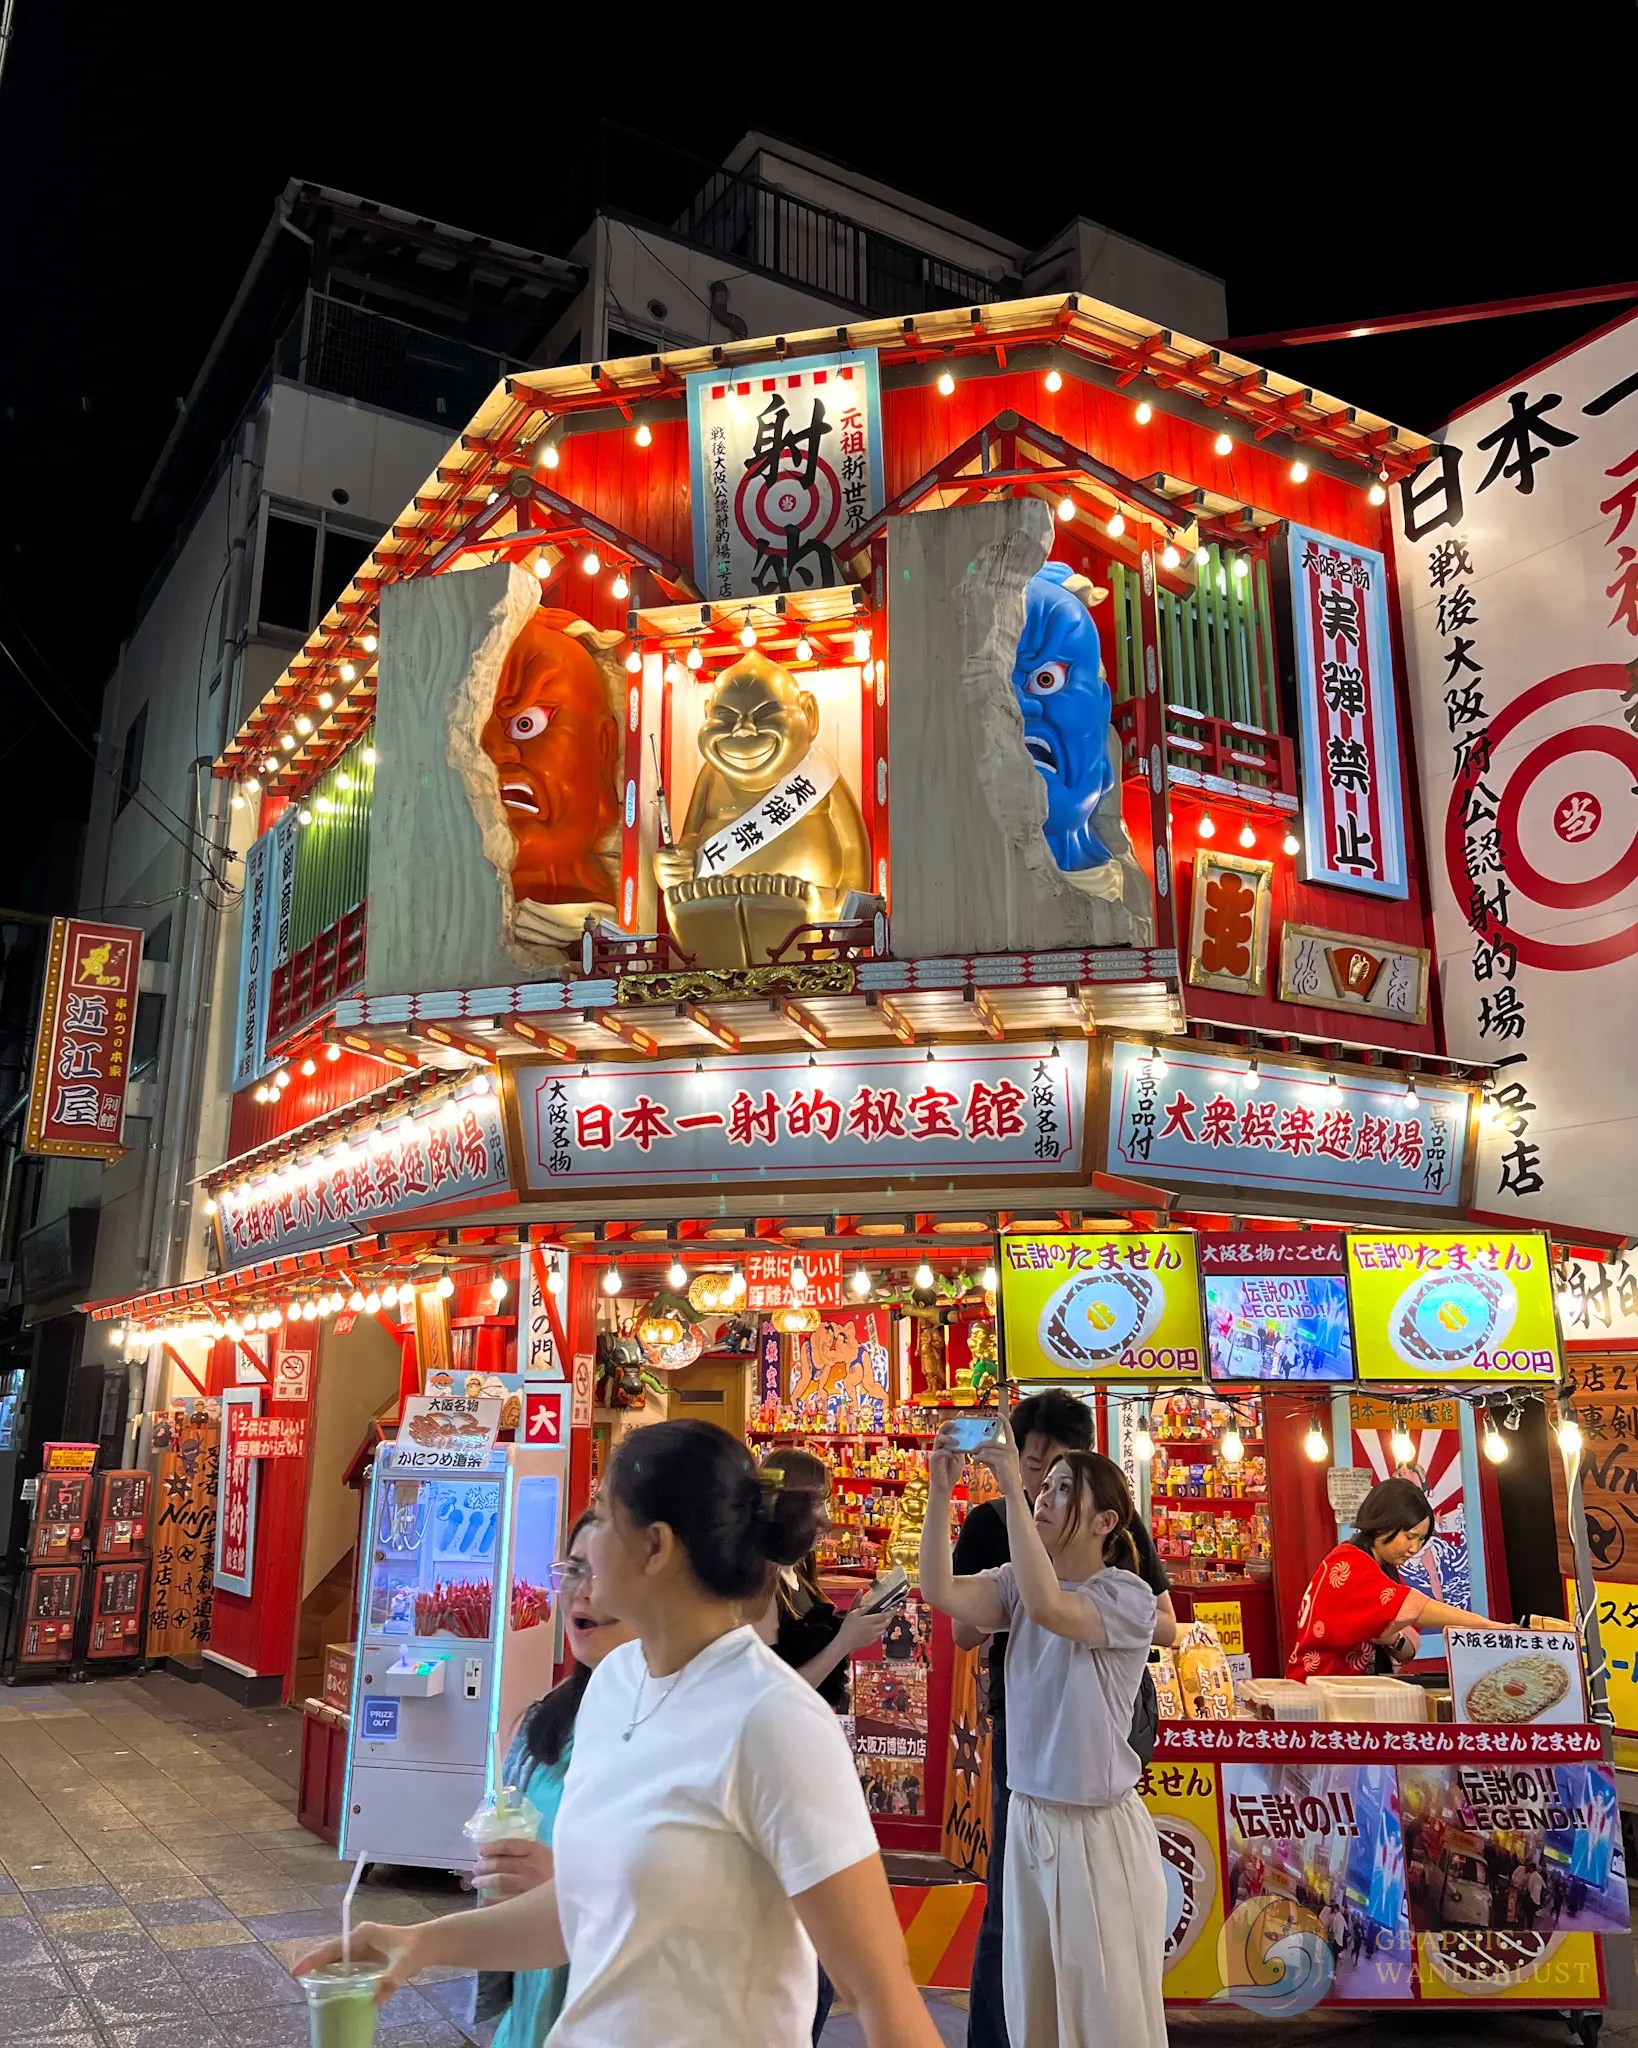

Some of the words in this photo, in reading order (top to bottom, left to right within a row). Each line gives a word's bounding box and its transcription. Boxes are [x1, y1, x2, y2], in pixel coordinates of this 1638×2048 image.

[744, 394, 833, 593] 射的
[1301, 549, 1370, 591] 大阪名物
[1320, 591, 1376, 871] 実弾禁止
[704, 774, 817, 870] 実弾禁止
[1428, 536, 1545, 1198] 戦後大阪府公認射的場一号店
[51, 993, 109, 1126] 近江屋
[548, 1079, 573, 1173] 大阪名物
[573, 1080, 1030, 1153] 日本一射的秘宝館
[1031, 1060, 1060, 1159] 大阪名物
[488, 1113, 507, 1180] 品付
[1157, 1090, 1425, 1172] 大衆娯楽遊戯場
[1422, 1103, 1450, 1191] 景品付
[749, 1253, 840, 1280] 子供にしい!
[1006, 1241, 1182, 1271] 伝説のたません
[1202, 1243, 1342, 1263] 大阪名物たこせん
[1353, 1241, 1532, 1271] 伝説のたません
[1119, 1348, 1199, 1371] 400円
[1473, 1350, 1555, 1374] 400円
[429, 1398, 480, 1412] 大阪名物
[1451, 1632, 1576, 1651] 大阪名物たません
[370, 1711, 394, 1719] PRIZE
[373, 1719, 390, 1727] OUT
[857, 1735, 927, 1757] 大阪万博協力店
[1163, 1728, 1233, 1748] たません
[1237, 1729, 1306, 1749] たません
[1310, 1730, 1380, 1750] たません
[1383, 1730, 1454, 1751] たません
[1457, 1731, 1527, 1751] たません
[1531, 1731, 1601, 1752] たません
[1456, 1767, 1562, 1807] 伝説の!!
[946, 1800, 989, 1872] NINJA
[1229, 1792, 1360, 1839] 伝説の!!
[1456, 1808, 1588, 1832] LEGEND!!
